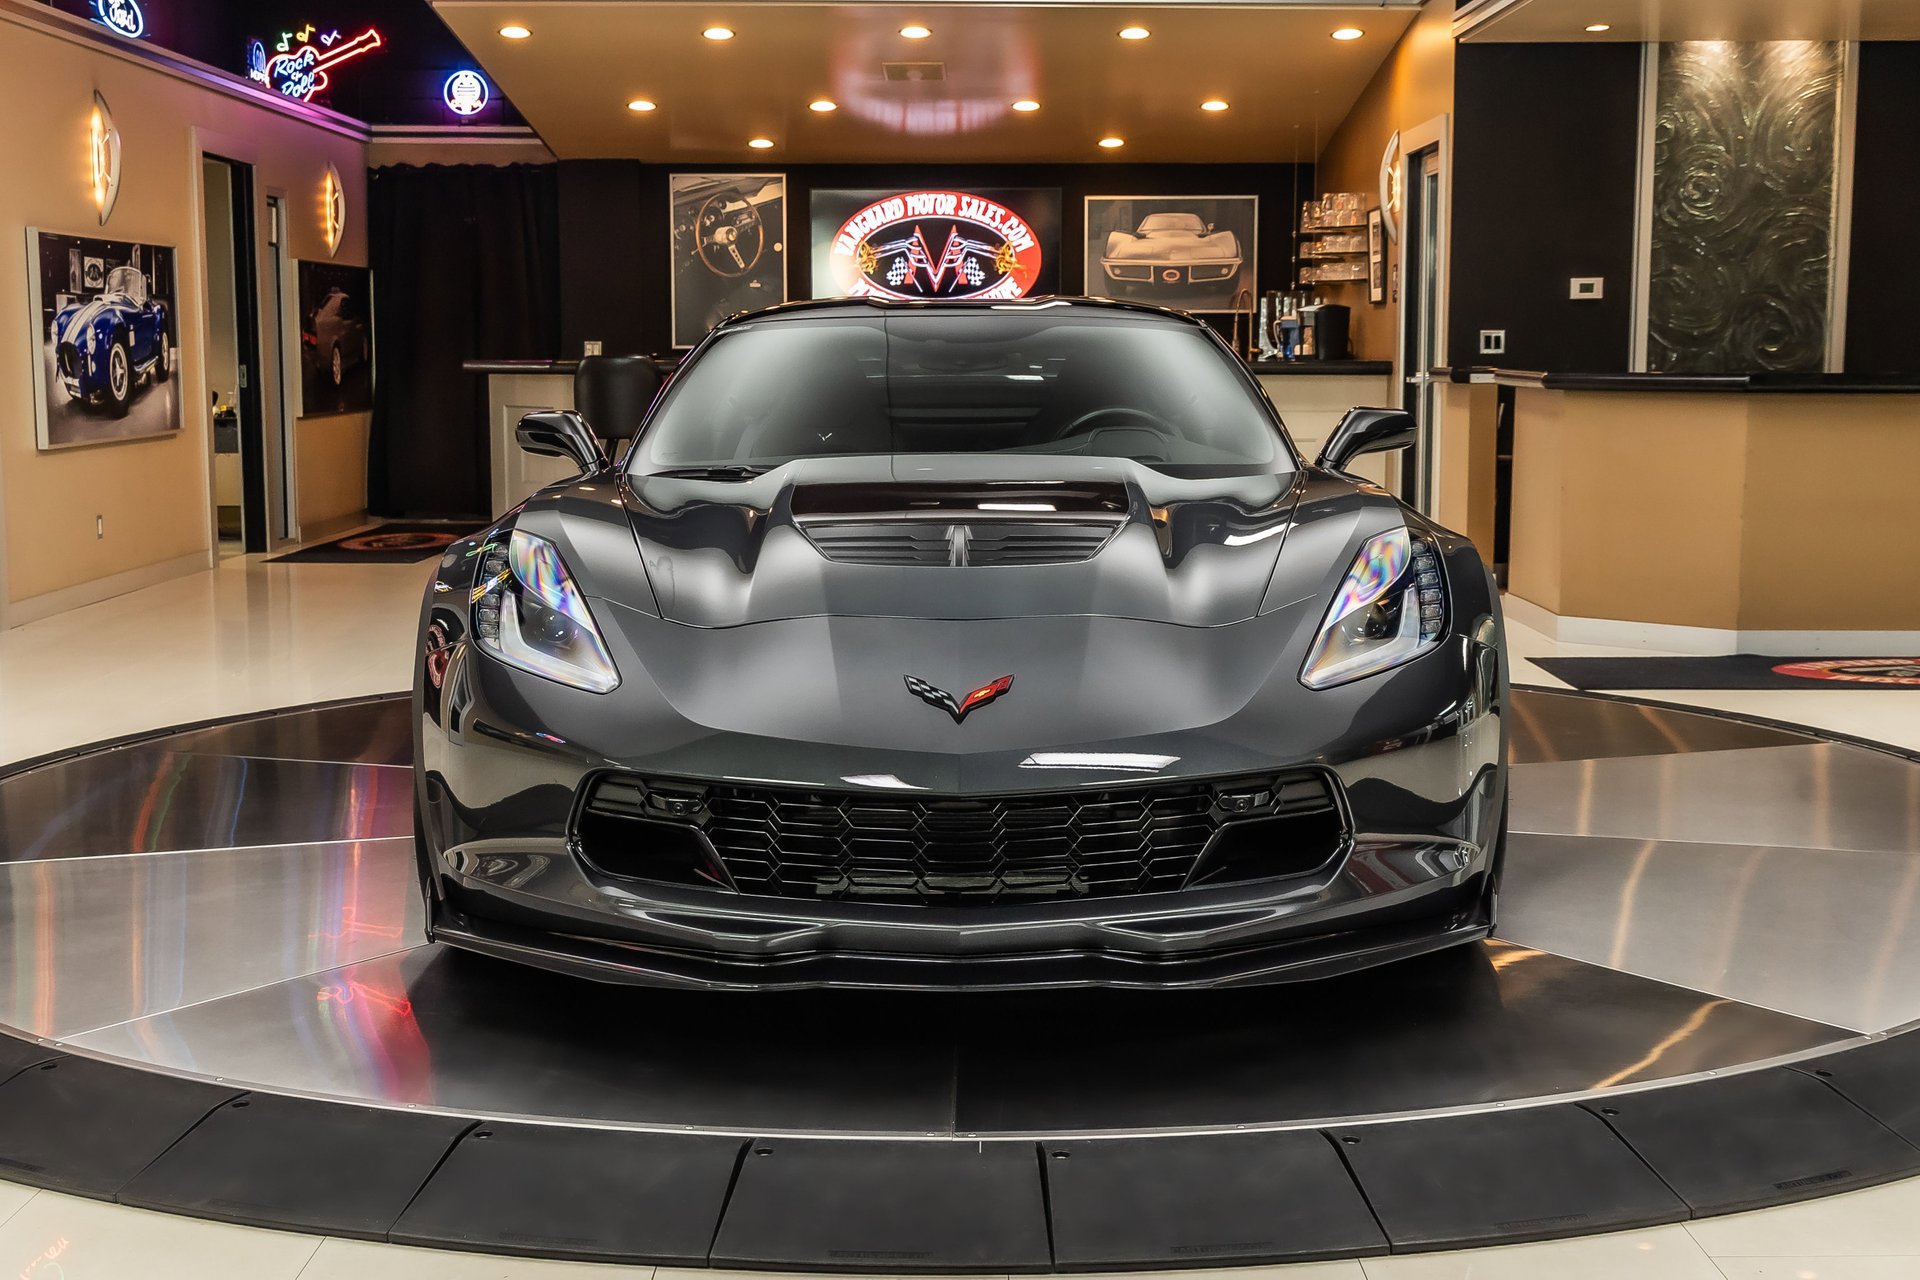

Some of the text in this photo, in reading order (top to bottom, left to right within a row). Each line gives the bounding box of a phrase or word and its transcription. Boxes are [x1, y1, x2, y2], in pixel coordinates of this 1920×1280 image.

[274, 48, 315, 78] Rock
[834, 193, 1035, 257] VANGUARD MOTOR SALES.COM
